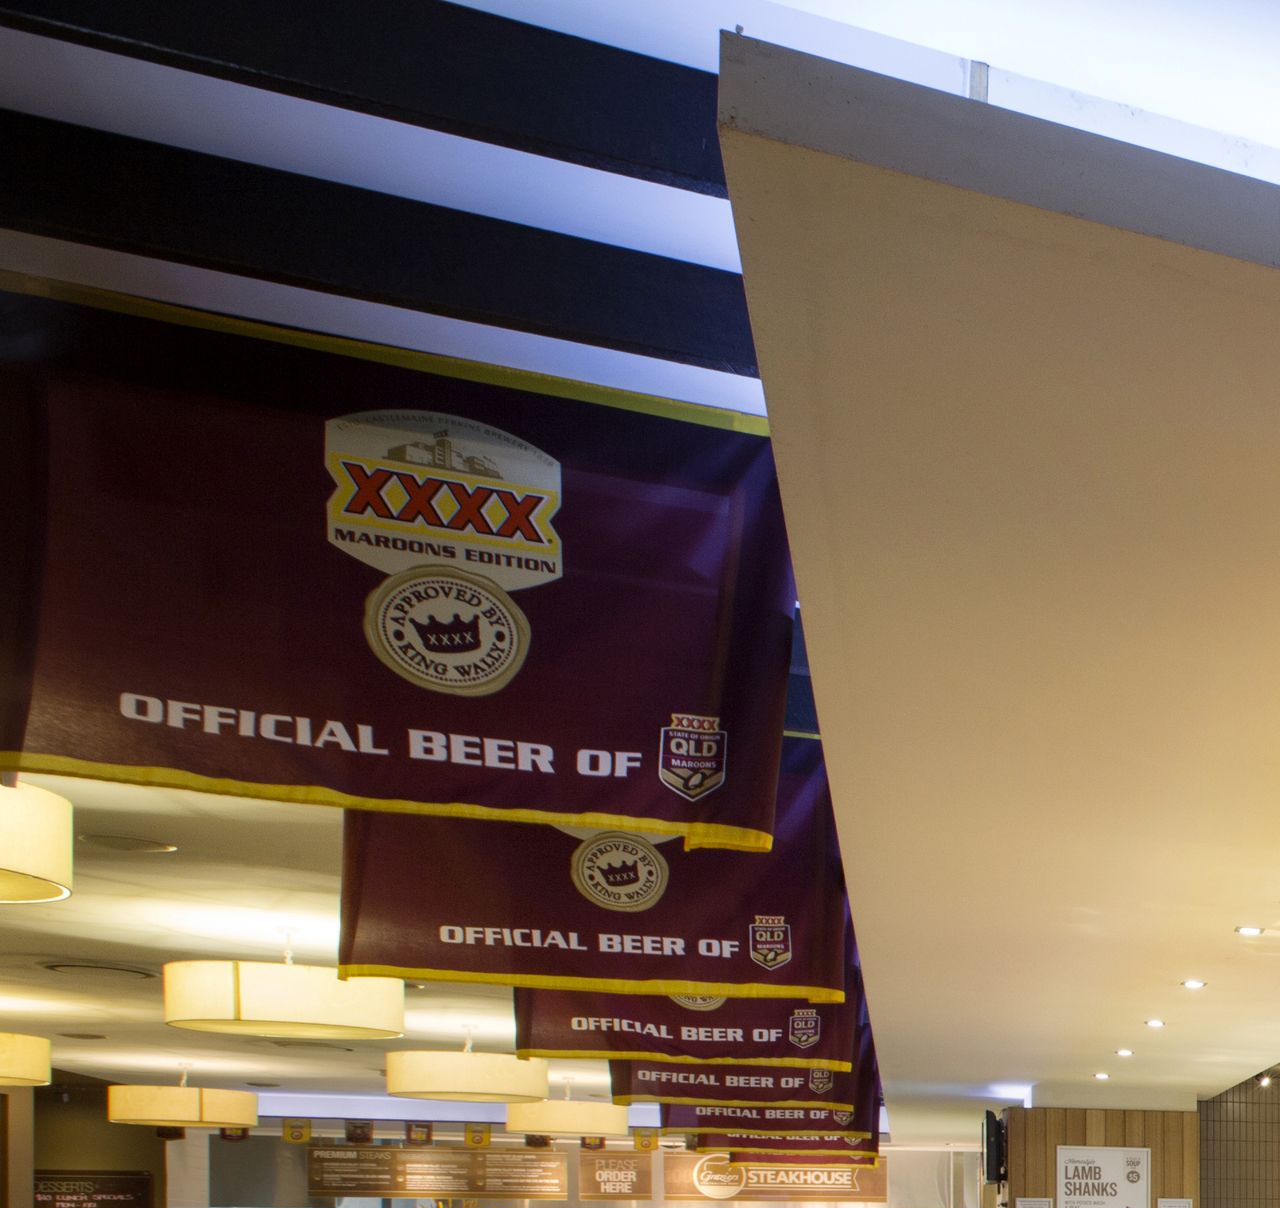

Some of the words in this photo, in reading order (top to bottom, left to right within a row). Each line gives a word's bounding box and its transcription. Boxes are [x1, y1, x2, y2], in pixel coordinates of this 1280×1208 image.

[341, 461, 545, 543] XXXX
[334, 527, 456, 559] MAROONS
[465, 548, 556, 573] EDITION
[390, 585, 482, 627] APPROVED
[481, 607, 505, 627] BY
[427, 631, 474, 646] XXXX
[398, 642, 448, 675] KING
[453, 642, 506, 677] WALLY
[119, 691, 389, 755] OFFICIAL
[408, 728, 555, 773] BEER
[577, 748, 643, 778] OF
[670, 738, 717, 757] QLD
[671, 758, 716, 768] MAROONS
[586, 843, 638, 872] APPROVED
[639, 855, 653, 868] BY
[592, 881, 621, 900] KING
[624, 879, 654, 900] WALLY
[439, 925, 588, 951] OFFICIAL
[598, 933, 686, 956] BEER
[698, 938, 740, 958] OF
[756, 930, 784, 942] QLD
[571, 1016, 674, 1040] OFFICIAL
[680, 1026, 744, 1042] BEER
[752, 1028, 783, 1042] OF
[794, 1020, 814, 1030] QLD
[637, 1070, 720, 1085] OFFICIAL
[725, 1076, 774, 1088] BEER
[780, 1077, 805, 1089] OF
[695, 1106, 761, 1119] OFFICIAL
[765, 1109, 804, 1119] BEER
[810, 1110, 829, 1119] OF
[313, 1151, 357, 1159] PREMIUM
[359, 1152, 391, 1160] STEAKS
[595, 1159, 638, 1170] PLEASE
[595, 1170, 636, 1182] ORDER
[747, 1170, 852, 1185] STEAKHOUSE
[1064, 1165, 1102, 1180] LAMB
[600, 1182, 632, 1193] HERE
[1064, 1182, 1118, 1196] SHANKS
